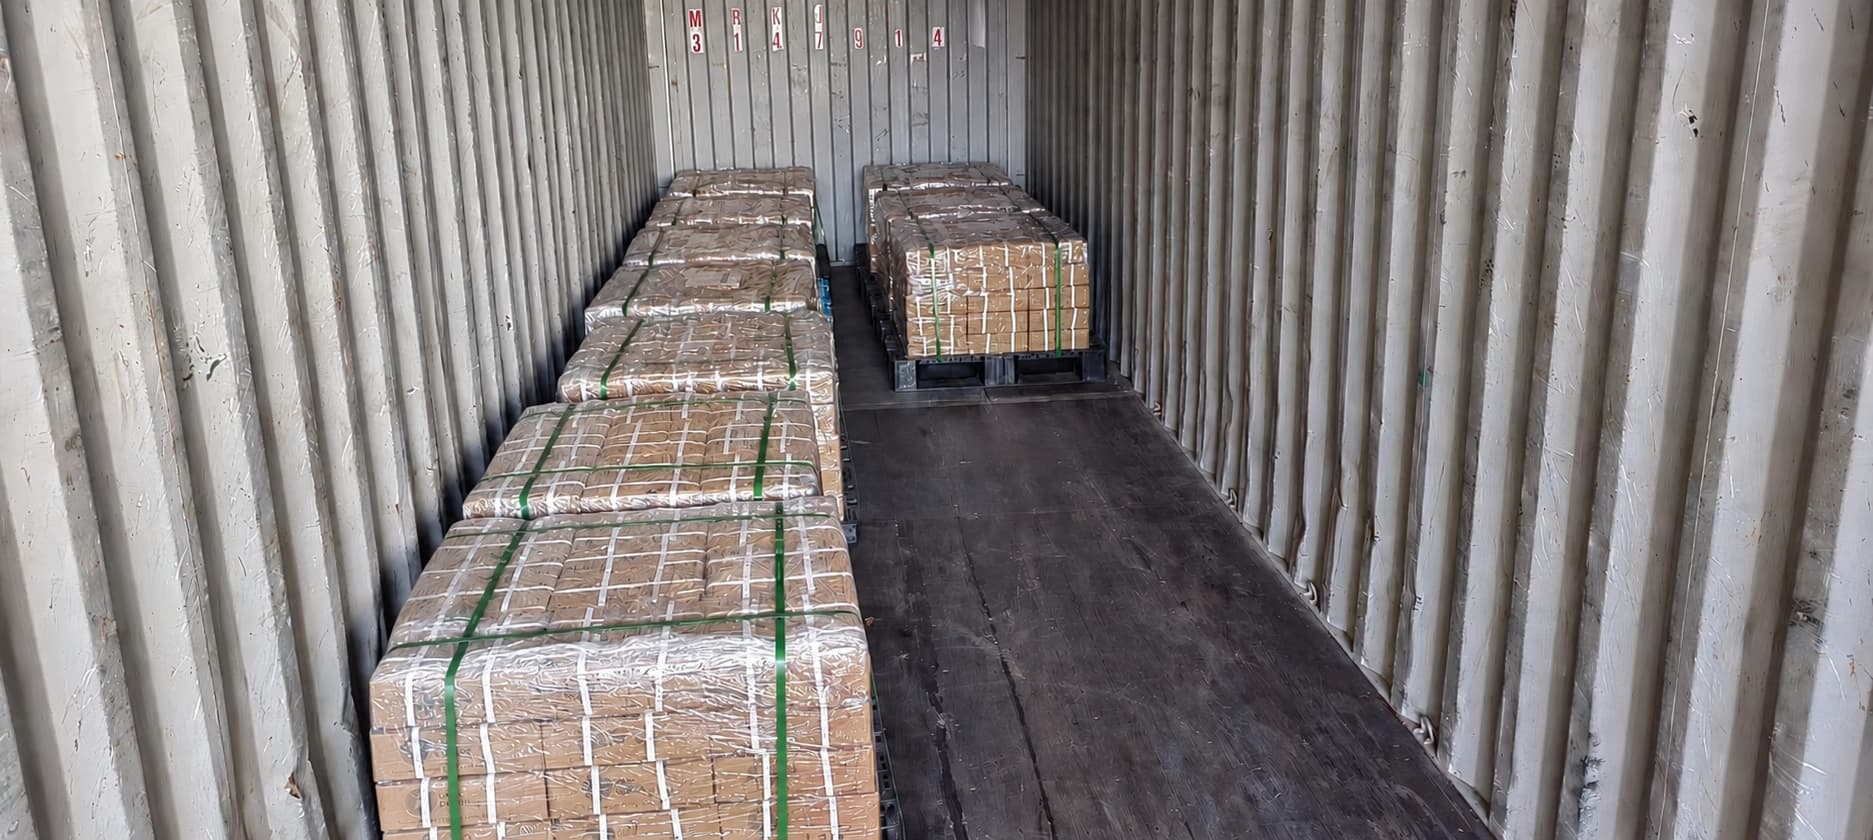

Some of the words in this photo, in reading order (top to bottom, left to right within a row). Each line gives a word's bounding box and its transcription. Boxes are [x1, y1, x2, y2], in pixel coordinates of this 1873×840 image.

[689, 10, 701, 27] M
[731, 9, 740, 25] R
[771, 9, 780, 25] K
[692, 34, 701, 52] 3
[772, 32, 781, 48] 4
[815, 32, 823, 48] 7
[855, 30, 863, 48] 9
[934, 28, 942, 46] 4
